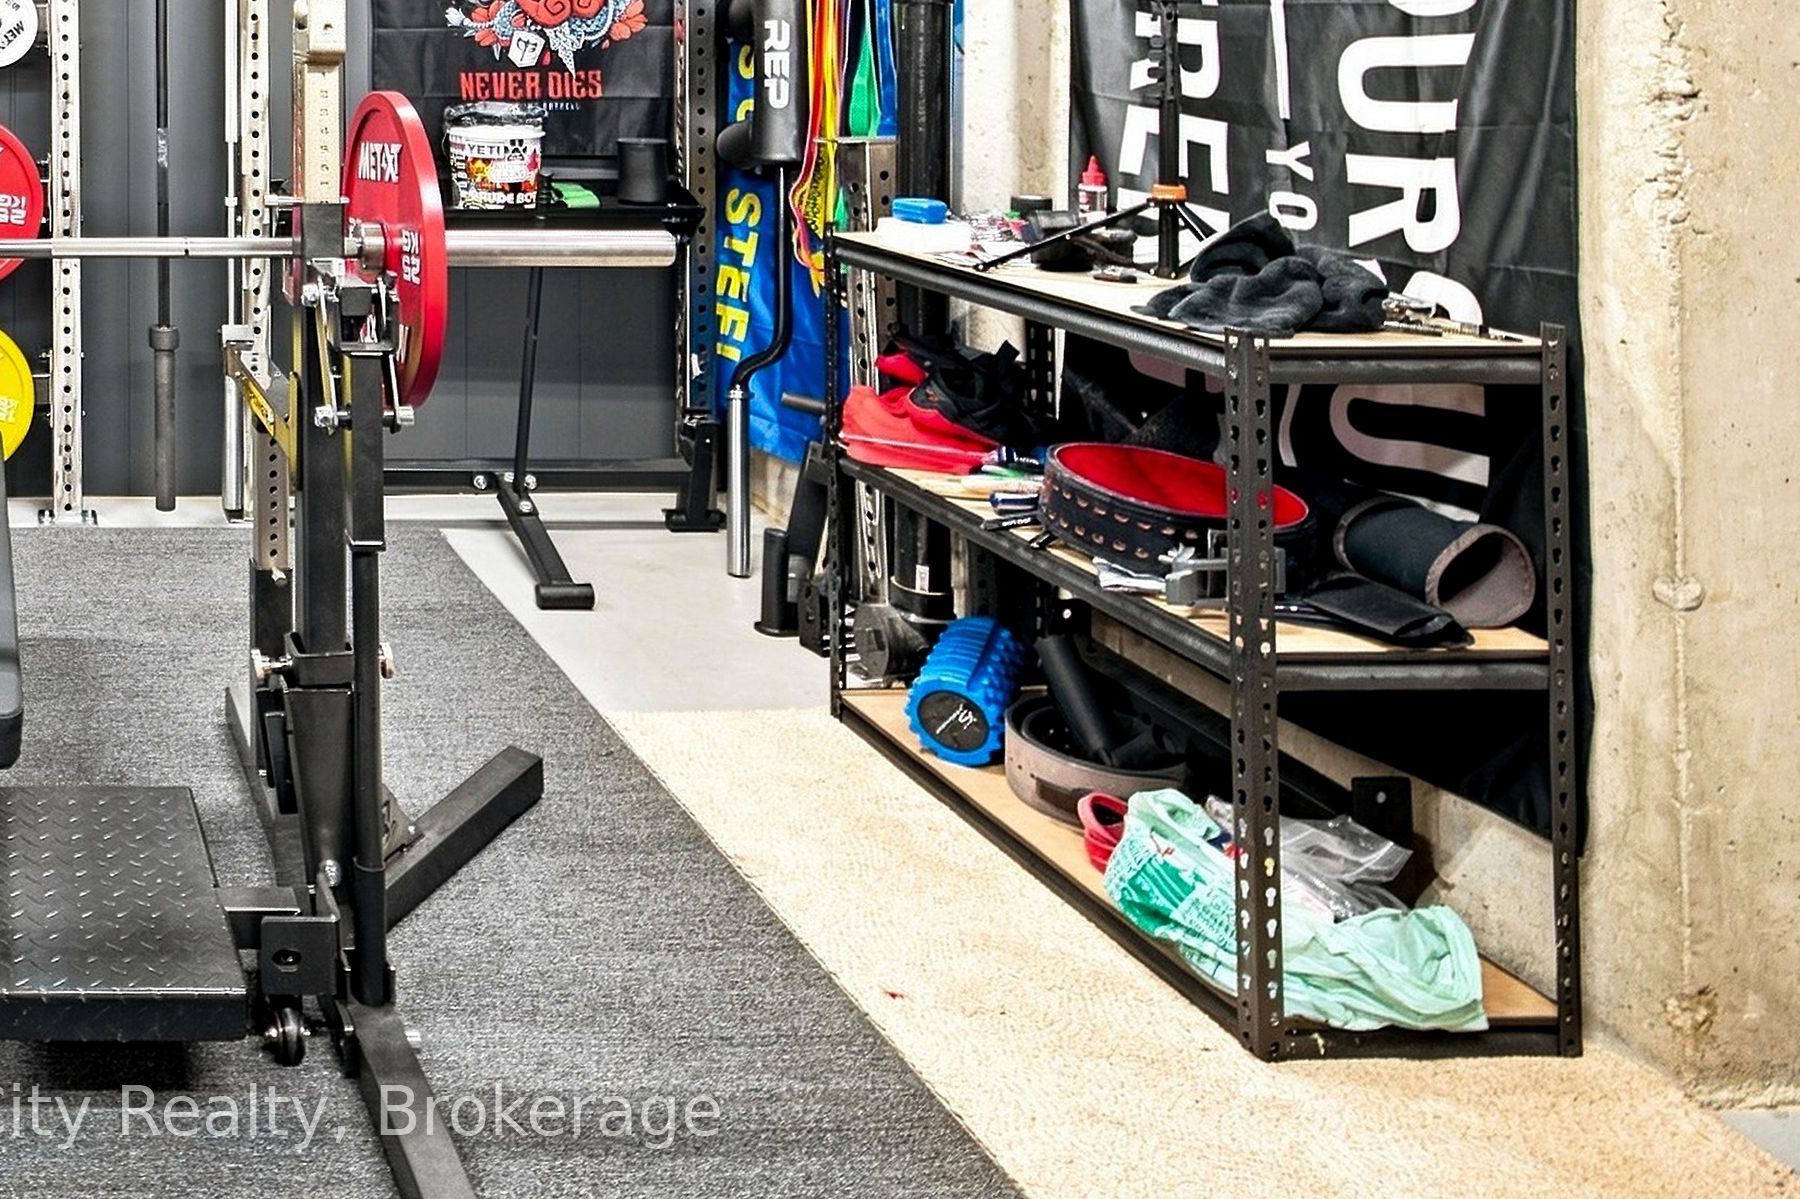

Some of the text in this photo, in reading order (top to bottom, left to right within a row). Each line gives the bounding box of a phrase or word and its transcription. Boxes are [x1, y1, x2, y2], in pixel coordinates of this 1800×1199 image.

[763, 18, 791, 110] REP
[459, 70, 603, 101] NEVER DIES
[467, 142, 501, 156] YETI
[402, 228, 420, 254] KG
[402, 254, 422, 285] 25
